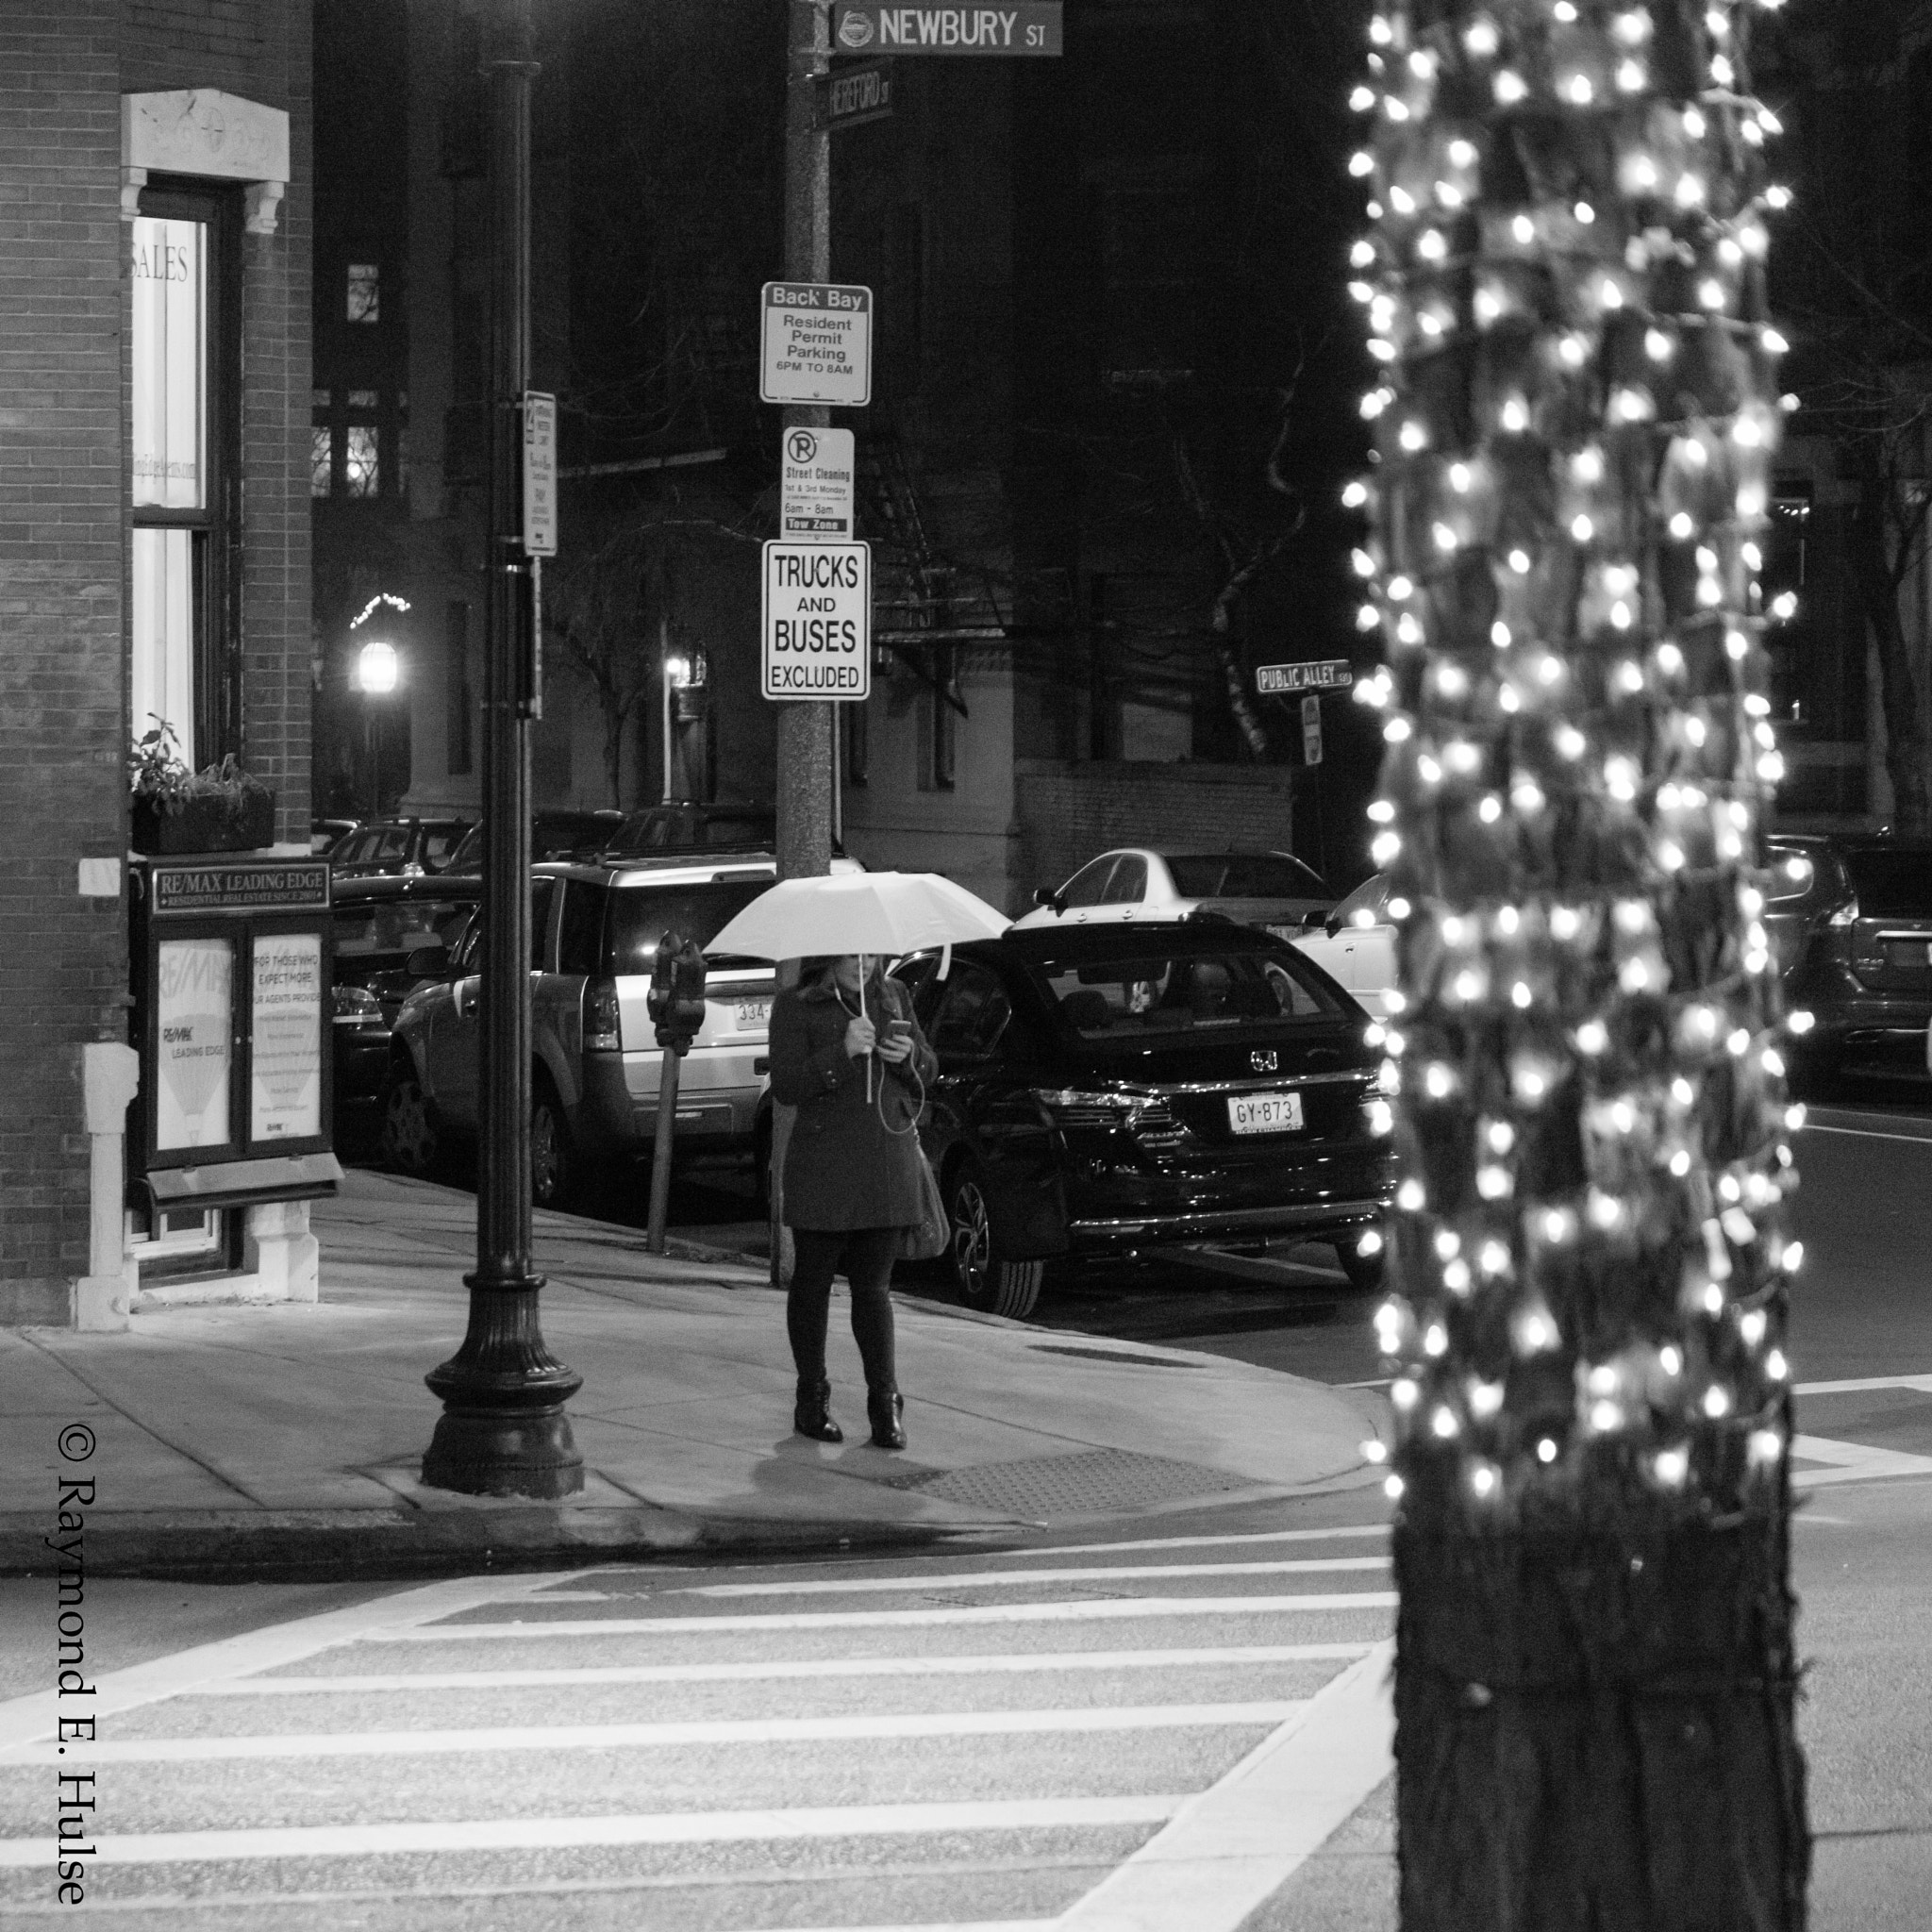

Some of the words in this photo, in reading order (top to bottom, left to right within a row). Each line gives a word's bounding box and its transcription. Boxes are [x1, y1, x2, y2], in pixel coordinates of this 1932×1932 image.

[879, 8, 1018, 46] NEWBURY
[1025, 25, 1046, 46] ST
[773, 287, 820, 306] Back
[827, 290, 862, 311] Bay
[783, 314, 852, 330] Resident
[791, 330, 842, 344] Permit
[787, 345, 846, 362] Parking
[776, 361, 802, 372] 6PM
[807, 362, 824, 373] TO
[826, 364, 853, 375] 8AM
[786, 466, 812, 479] Street
[815, 467, 850, 482] Cleaning
[819, 485, 846, 495] Monday
[785, 502, 804, 513] 6am
[814, 503, 834, 514] 8am
[788, 518, 809, 528] Tow
[813, 519, 838, 530] Zone
[774, 554, 858, 589] TRUCKS
[796, 597, 836, 612] AND
[774, 619, 856, 653] BUSES
[771, 665, 859, 688] EXCLUDED
[1260, 668, 1300, 689] PUBLIC
[1303, 665, 1335, 686] ALLEY
[161, 874, 223, 894] RE/MAX
[226, 873, 284, 891] LEADING
[286, 872, 324, 889] EDGE
